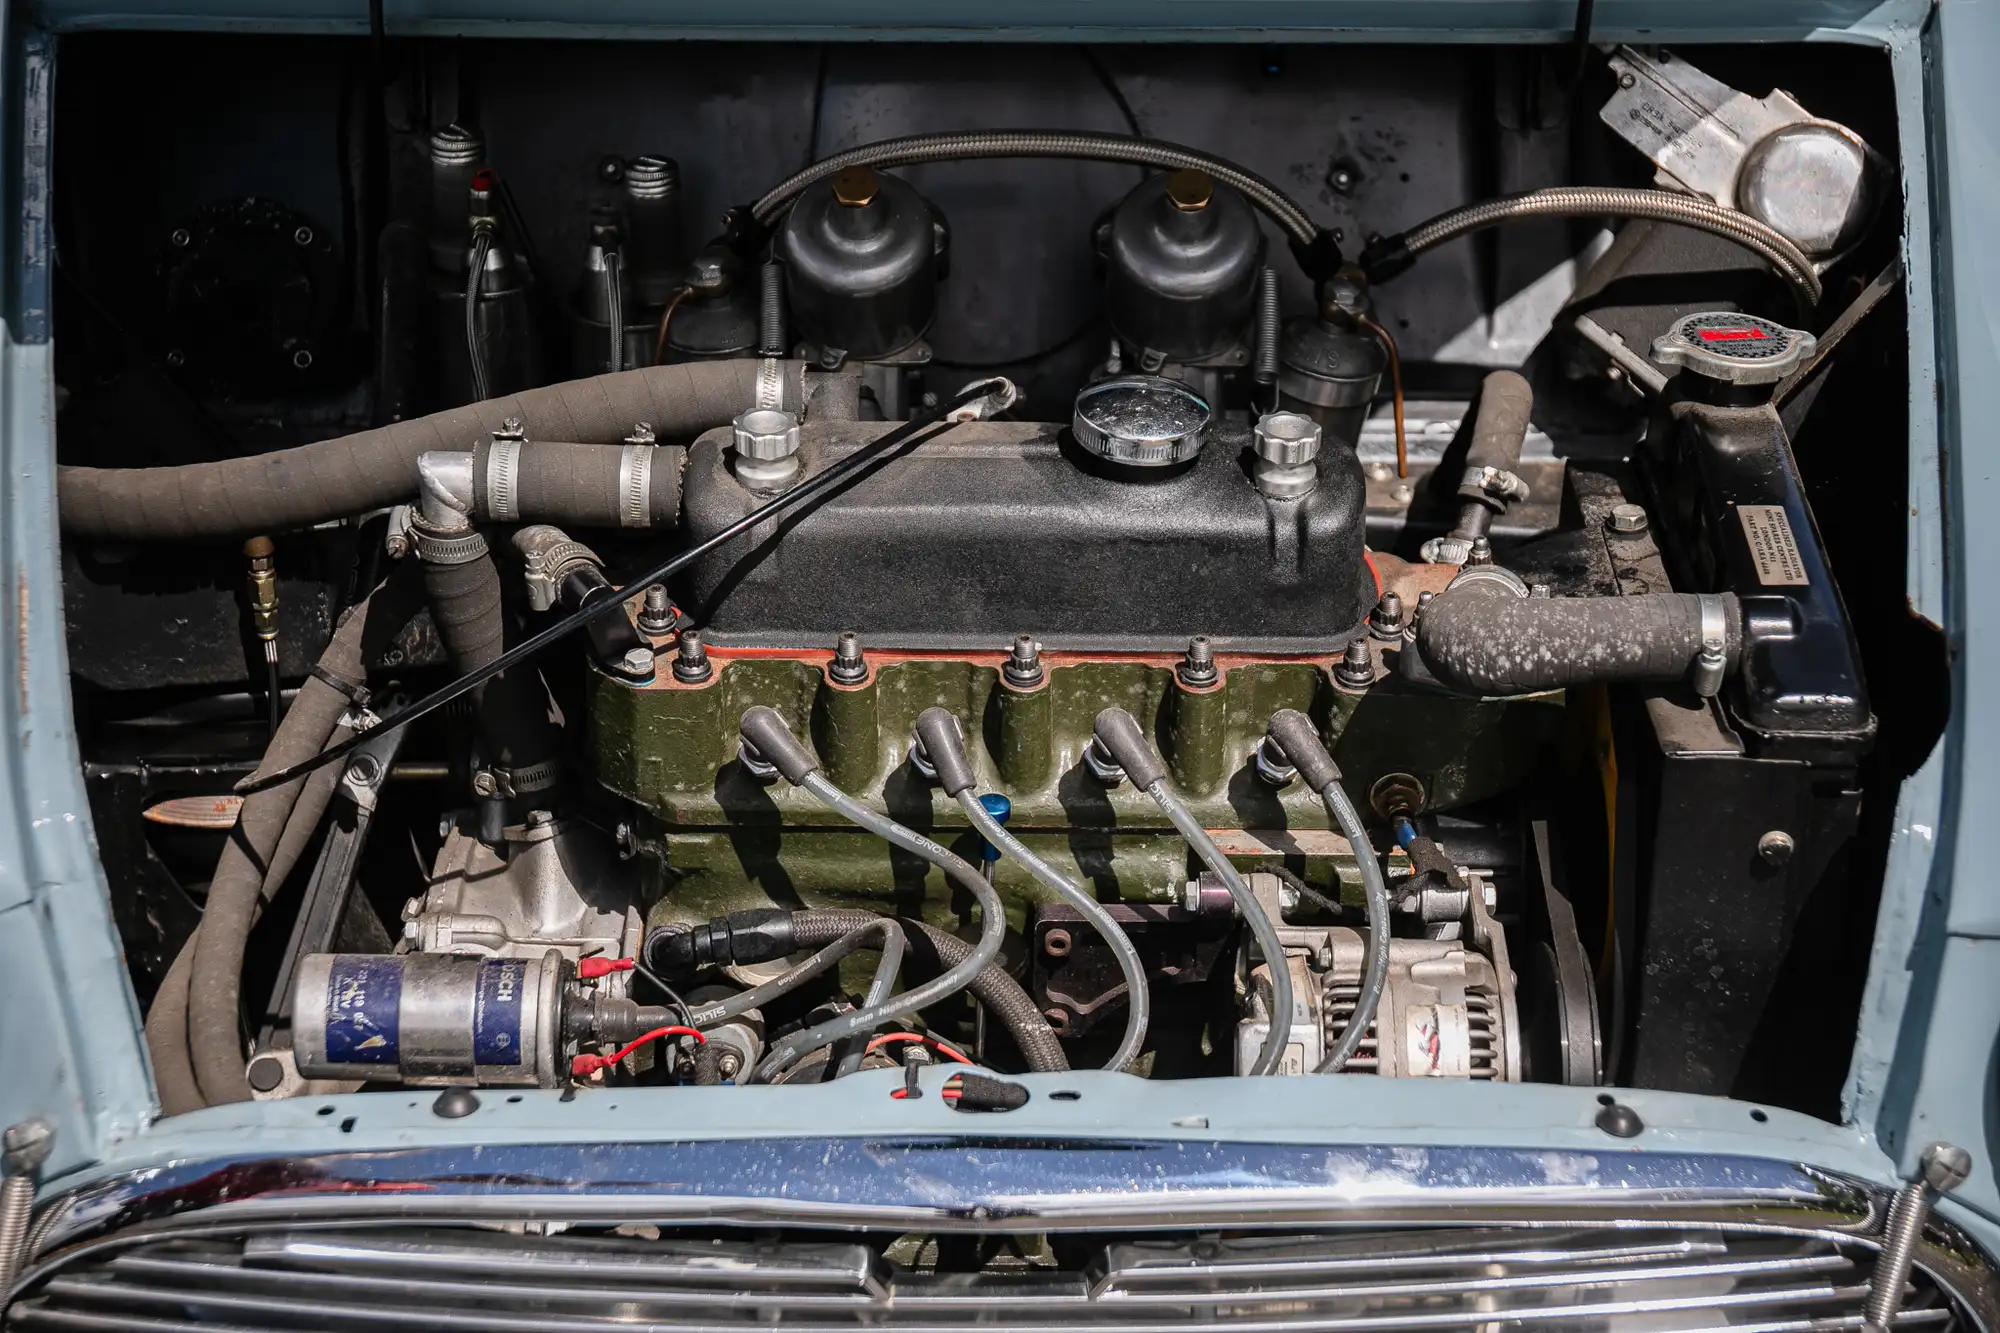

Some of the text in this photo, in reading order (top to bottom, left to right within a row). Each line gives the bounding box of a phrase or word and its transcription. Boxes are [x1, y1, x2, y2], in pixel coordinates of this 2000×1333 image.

[1746, 515, 1757, 528] PART
[1752, 530, 1760, 540] NO.
[1760, 526, 1773, 550] LONDON
[1764, 509, 1793, 580] MINI SPARES CENTRE LTD
[1787, 548, 1802, 578] RADIATOR
